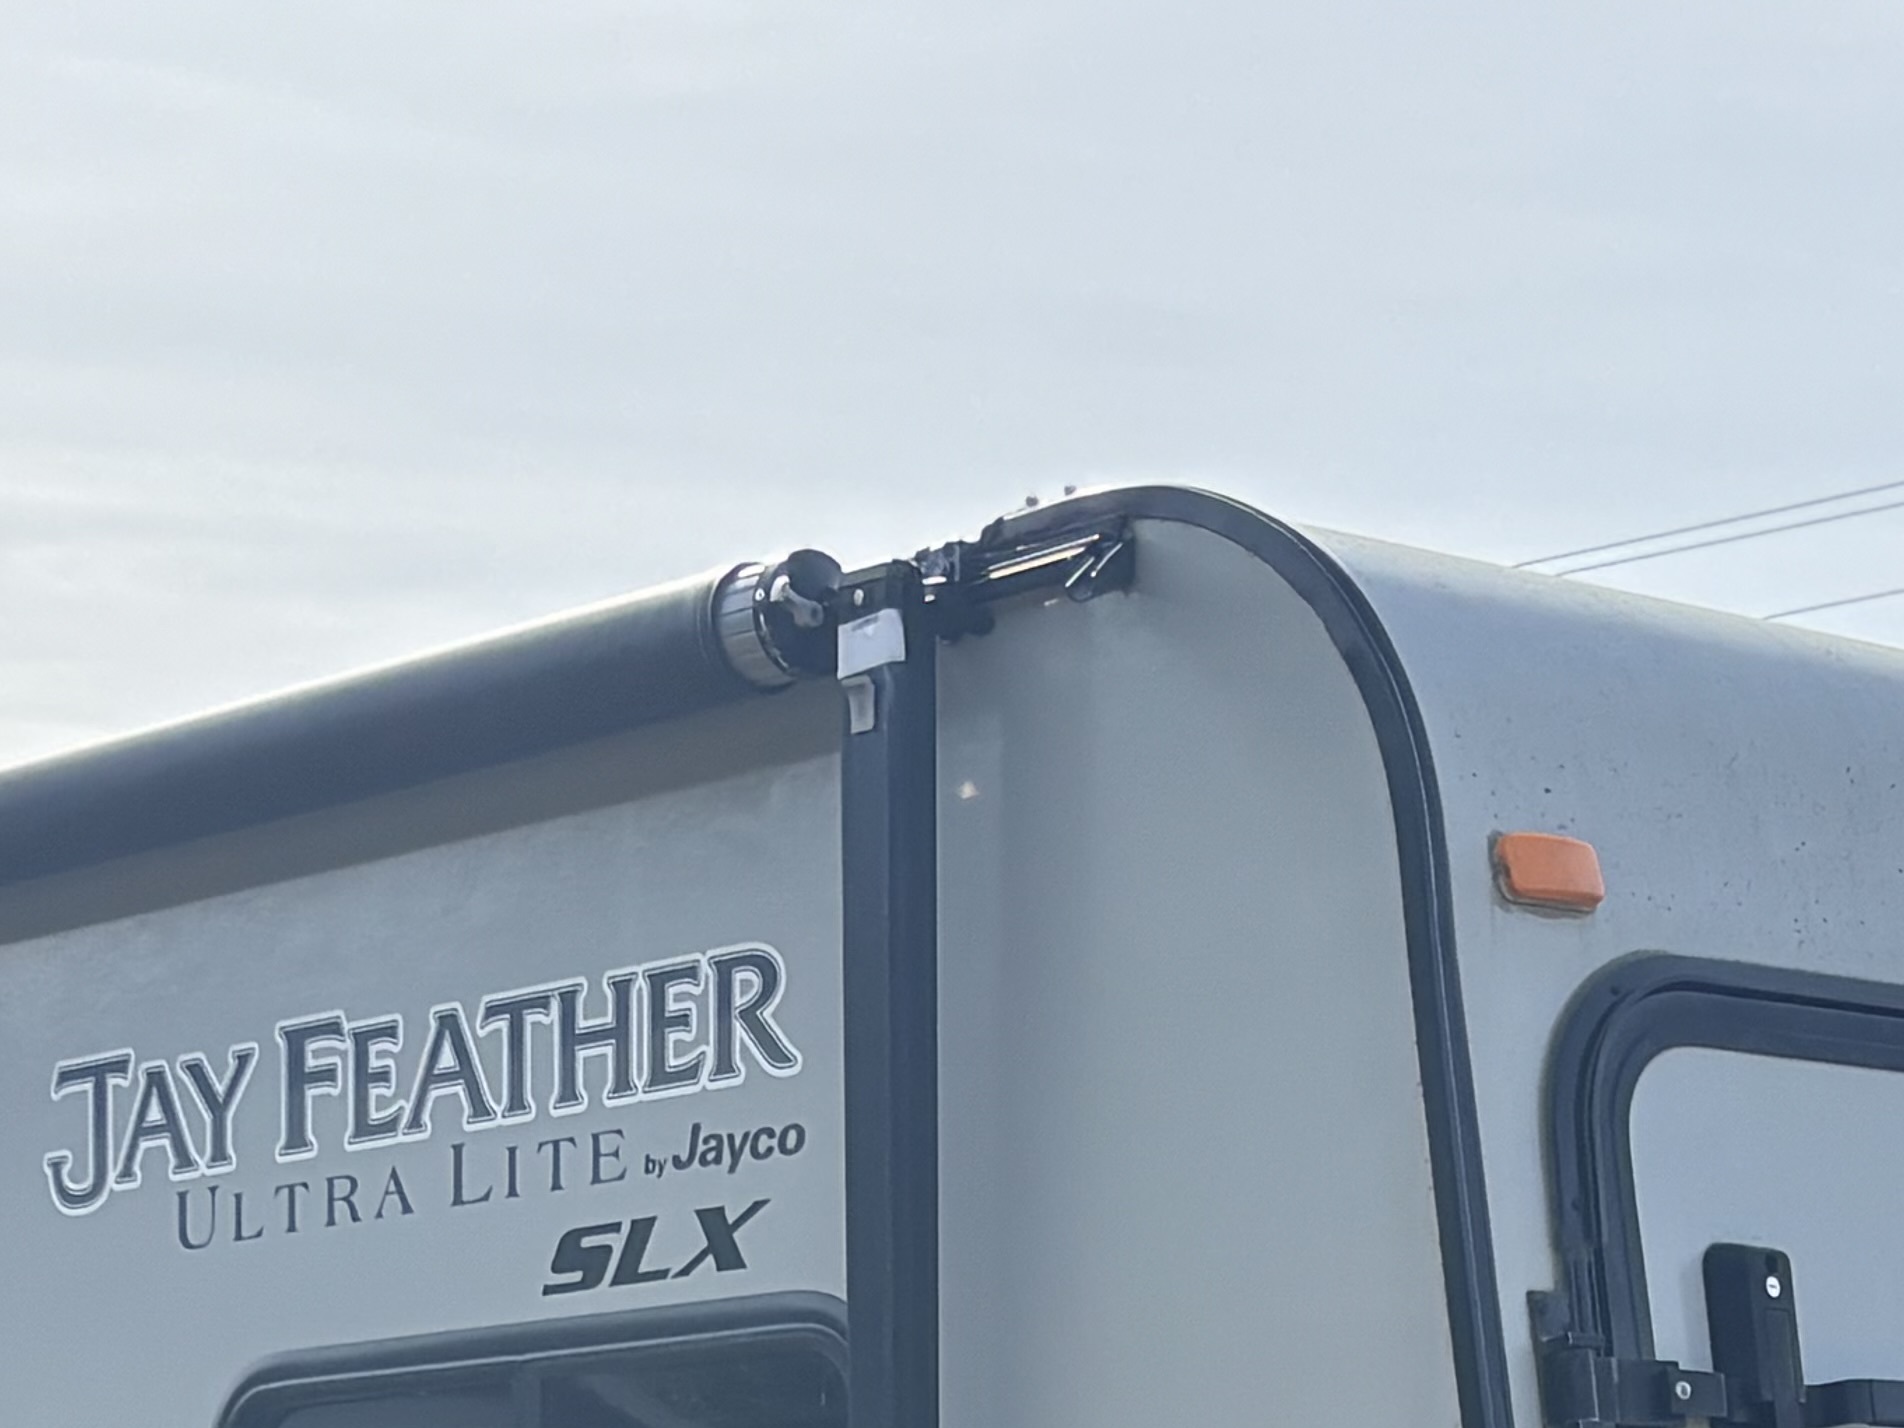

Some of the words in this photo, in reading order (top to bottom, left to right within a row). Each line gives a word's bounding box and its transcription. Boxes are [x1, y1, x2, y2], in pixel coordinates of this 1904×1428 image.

[44, 1043, 259, 1215] JAY
[274, 941, 802, 1162] FEATHER
[176, 1164, 415, 1250] ULTRA
[449, 1128, 628, 1206] LITE
[644, 1153, 667, 1179] by
[671, 1121, 806, 1175] Jayco
[542, 1198, 772, 1296] SLX
